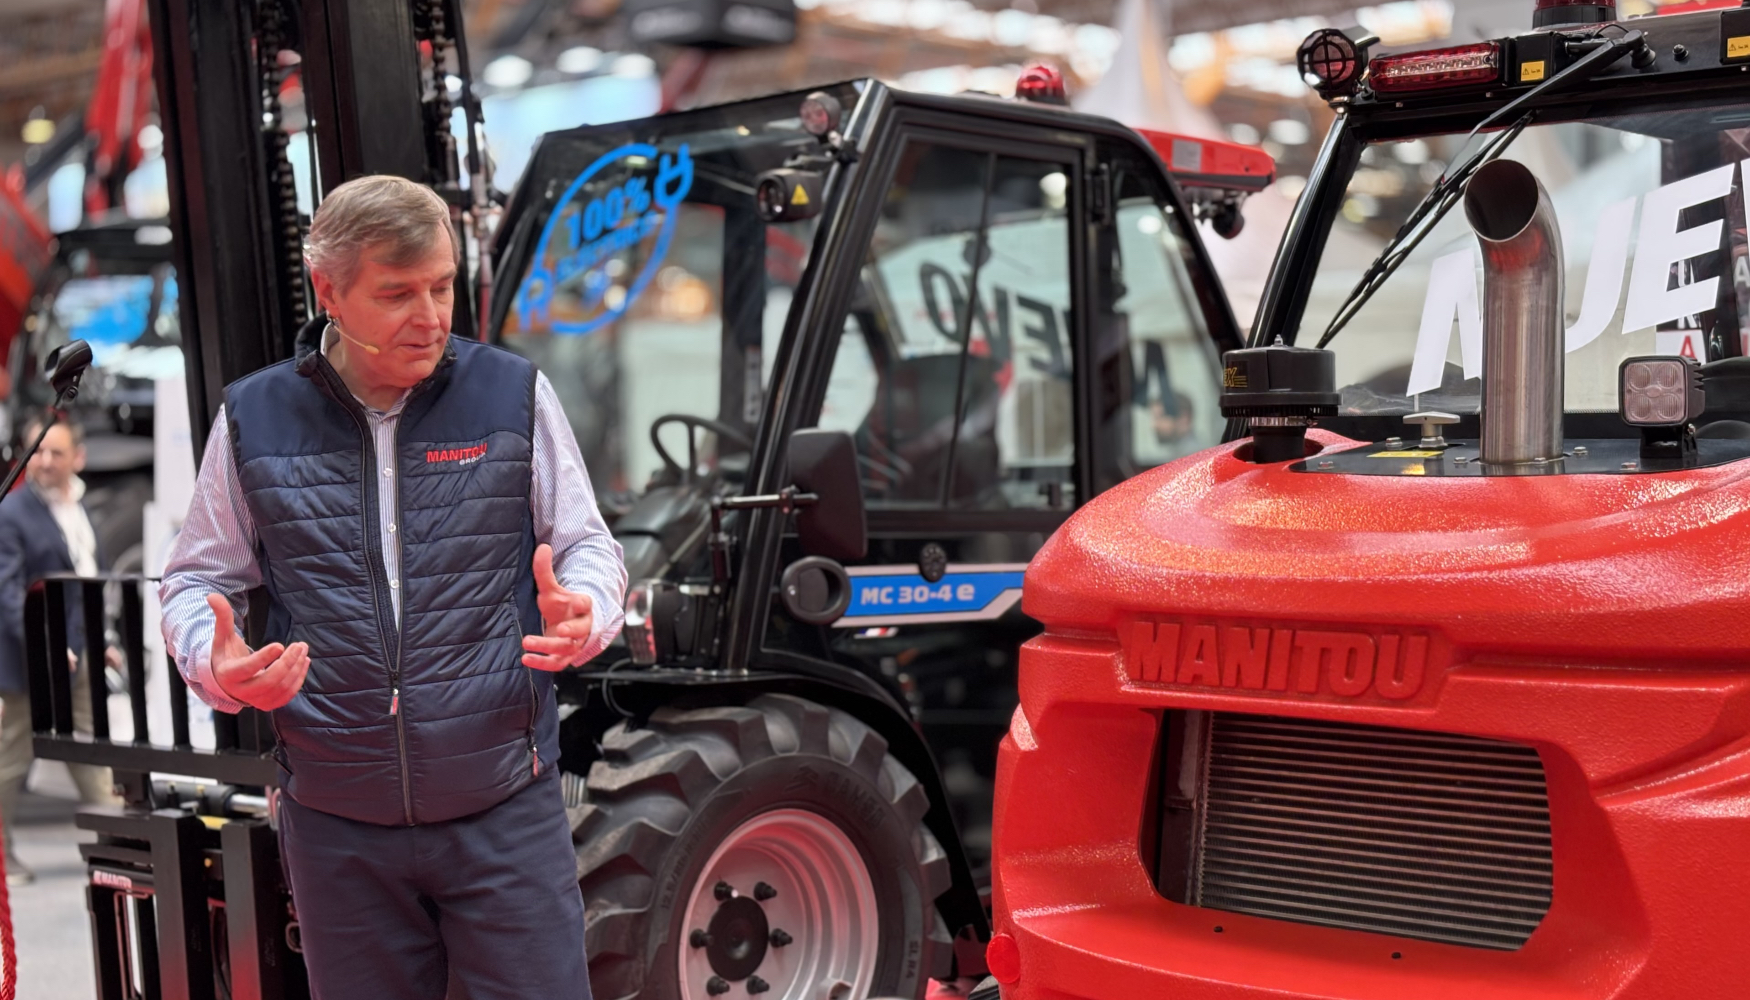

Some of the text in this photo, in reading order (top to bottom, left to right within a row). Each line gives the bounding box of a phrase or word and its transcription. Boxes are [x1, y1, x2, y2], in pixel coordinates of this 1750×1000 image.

[564, 176, 652, 250] 100%
[426, 442, 488, 463] MANITOU
[459, 452, 486, 465] GROUP
[861, 583, 975, 605] MC 30-4 e
[1129, 620, 1429, 700] MANITOU
